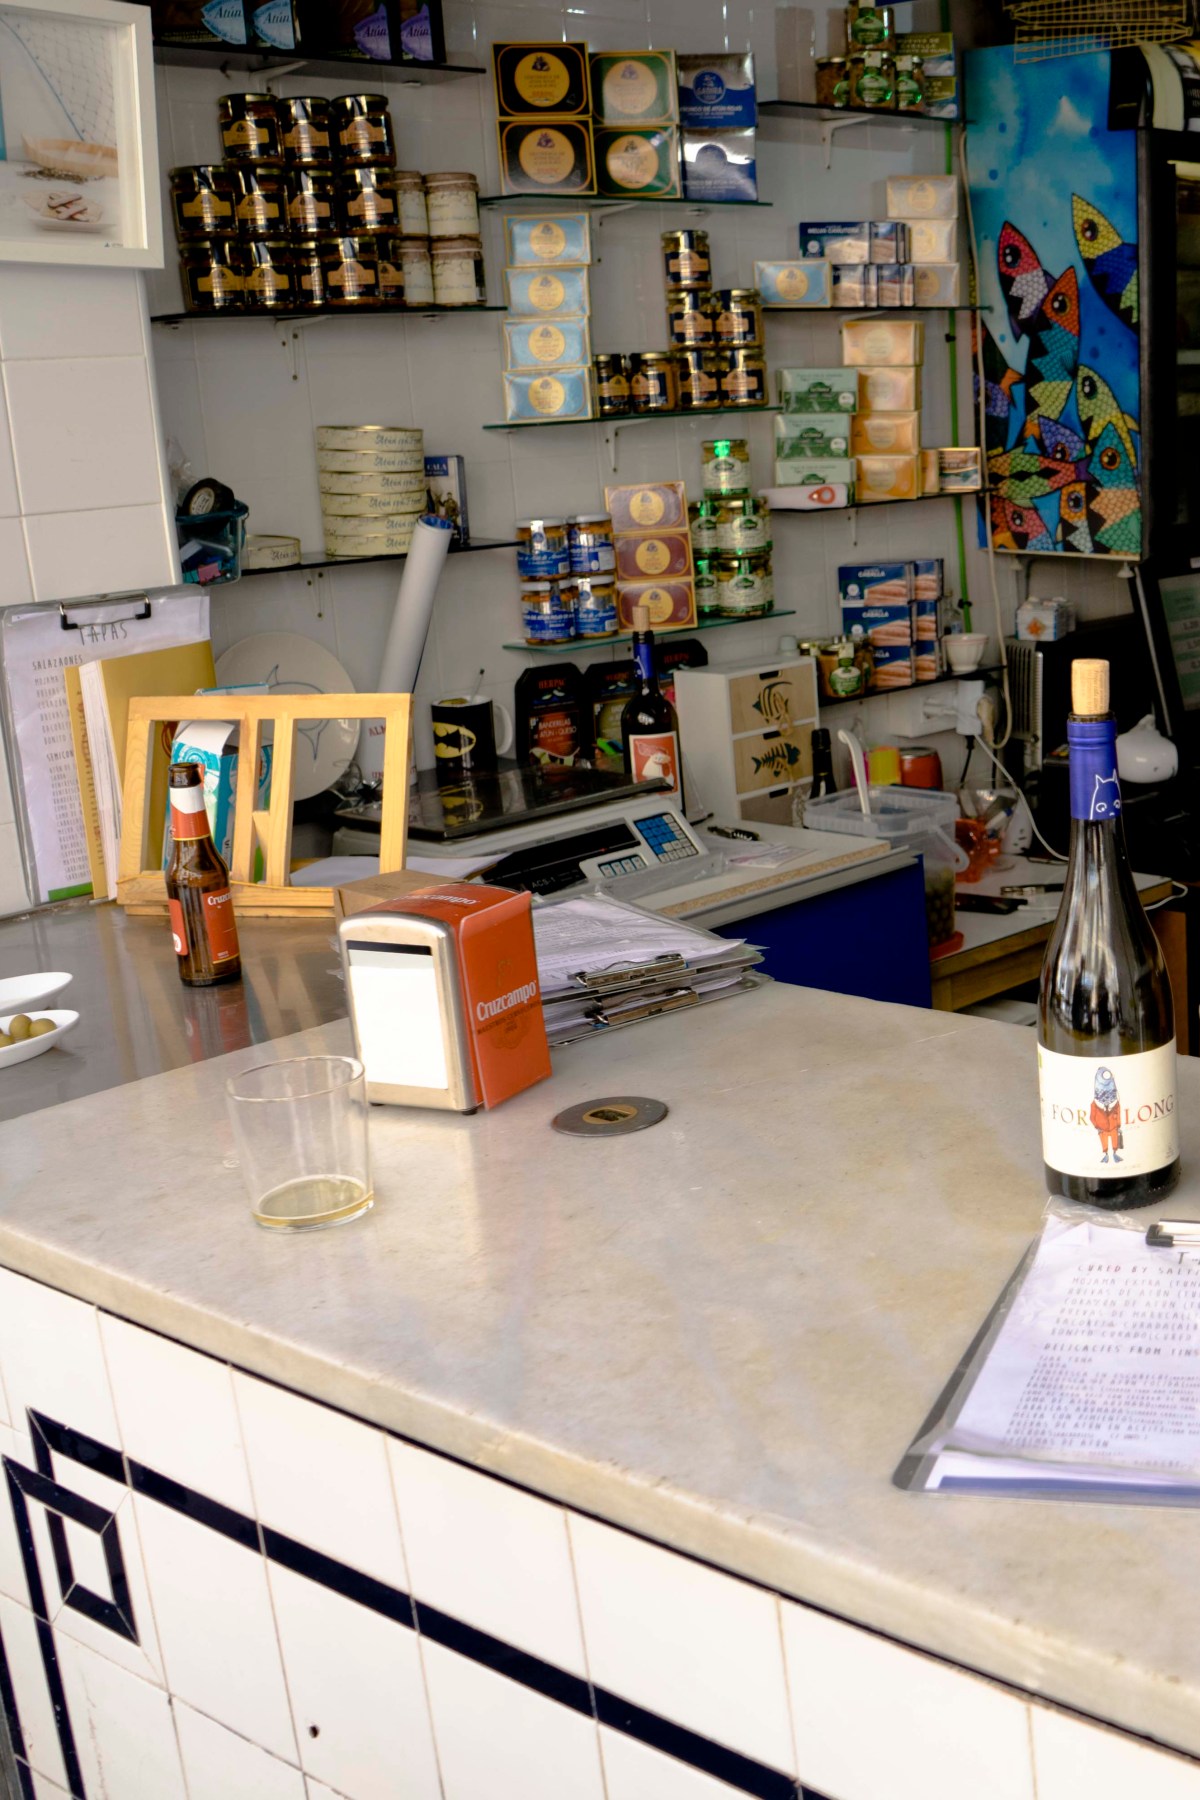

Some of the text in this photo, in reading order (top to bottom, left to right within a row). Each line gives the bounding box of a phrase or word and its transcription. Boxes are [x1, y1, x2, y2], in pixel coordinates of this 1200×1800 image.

[214, 6, 242, 20] Atún
[263, 11, 291, 26] Atún
[476, 980, 538, 1022] Cruzcampo
[1051, 1094, 1175, 1127] FOR LONG
